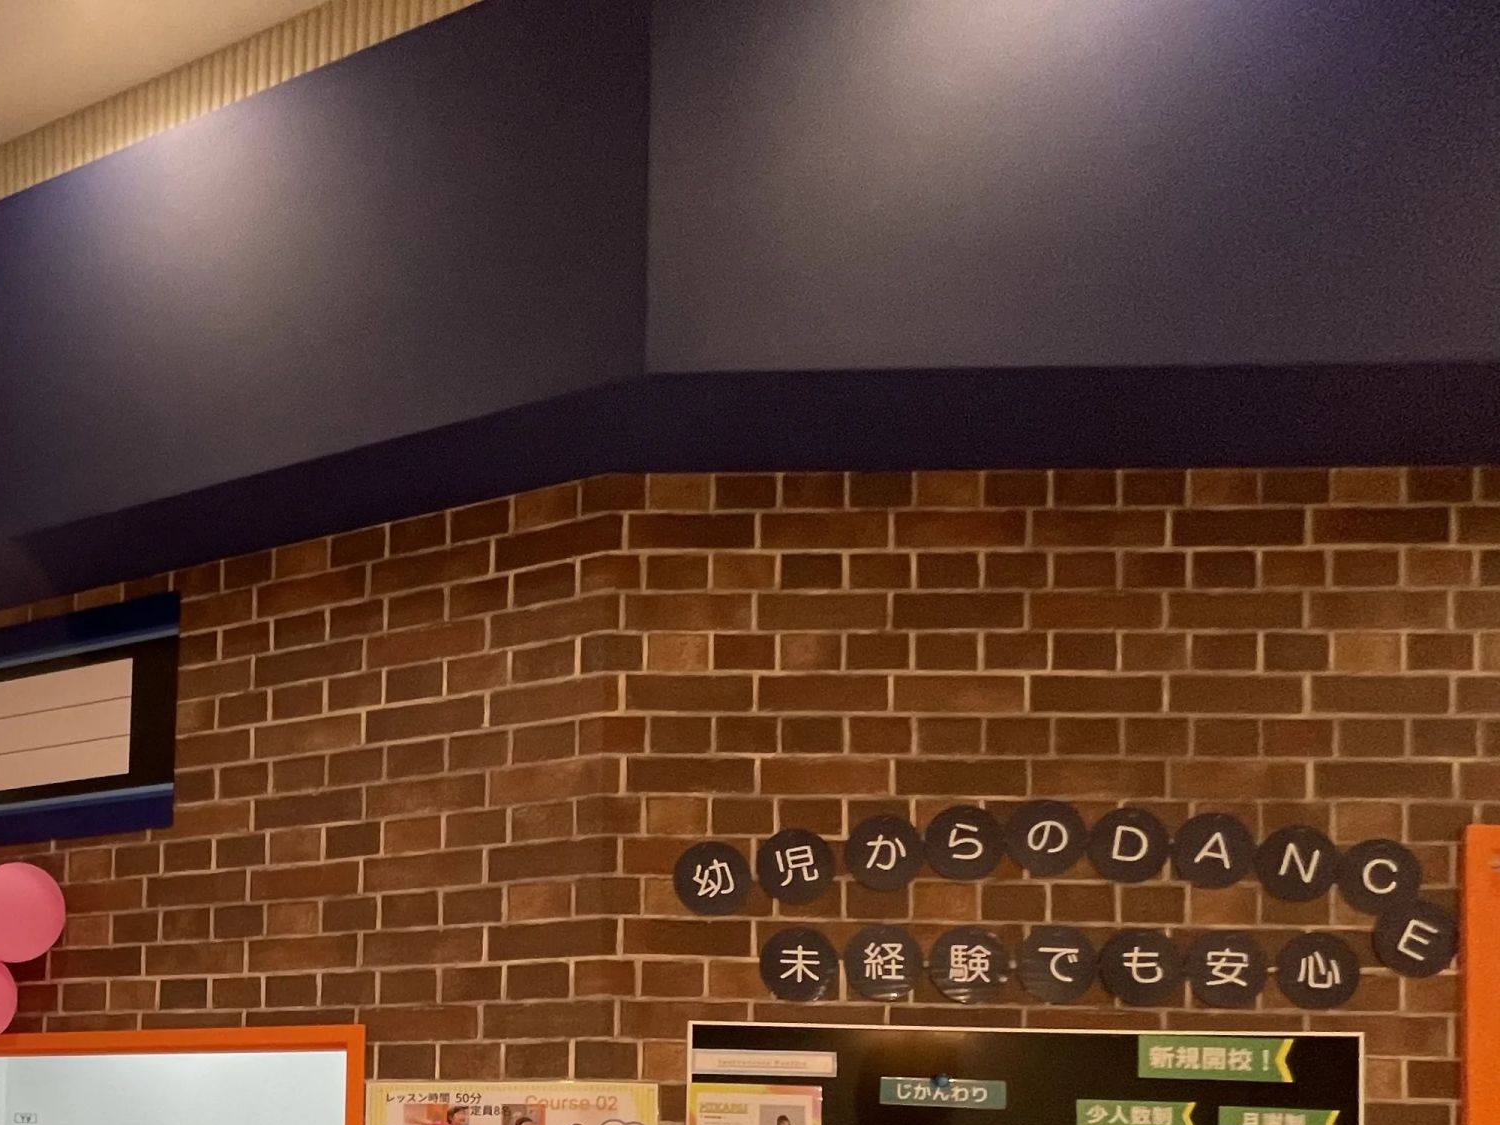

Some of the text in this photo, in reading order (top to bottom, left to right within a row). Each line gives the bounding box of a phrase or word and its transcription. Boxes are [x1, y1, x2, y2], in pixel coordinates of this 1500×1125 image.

[778, 942, 1342, 989] 未経験でも安心
[1148, 1045, 1271, 1073] 新規開校！
[455, 1092, 482, 1105] 50分
[896, 1082, 988, 1102] じかんわり
[525, 1094, 618, 1112] Course 02
